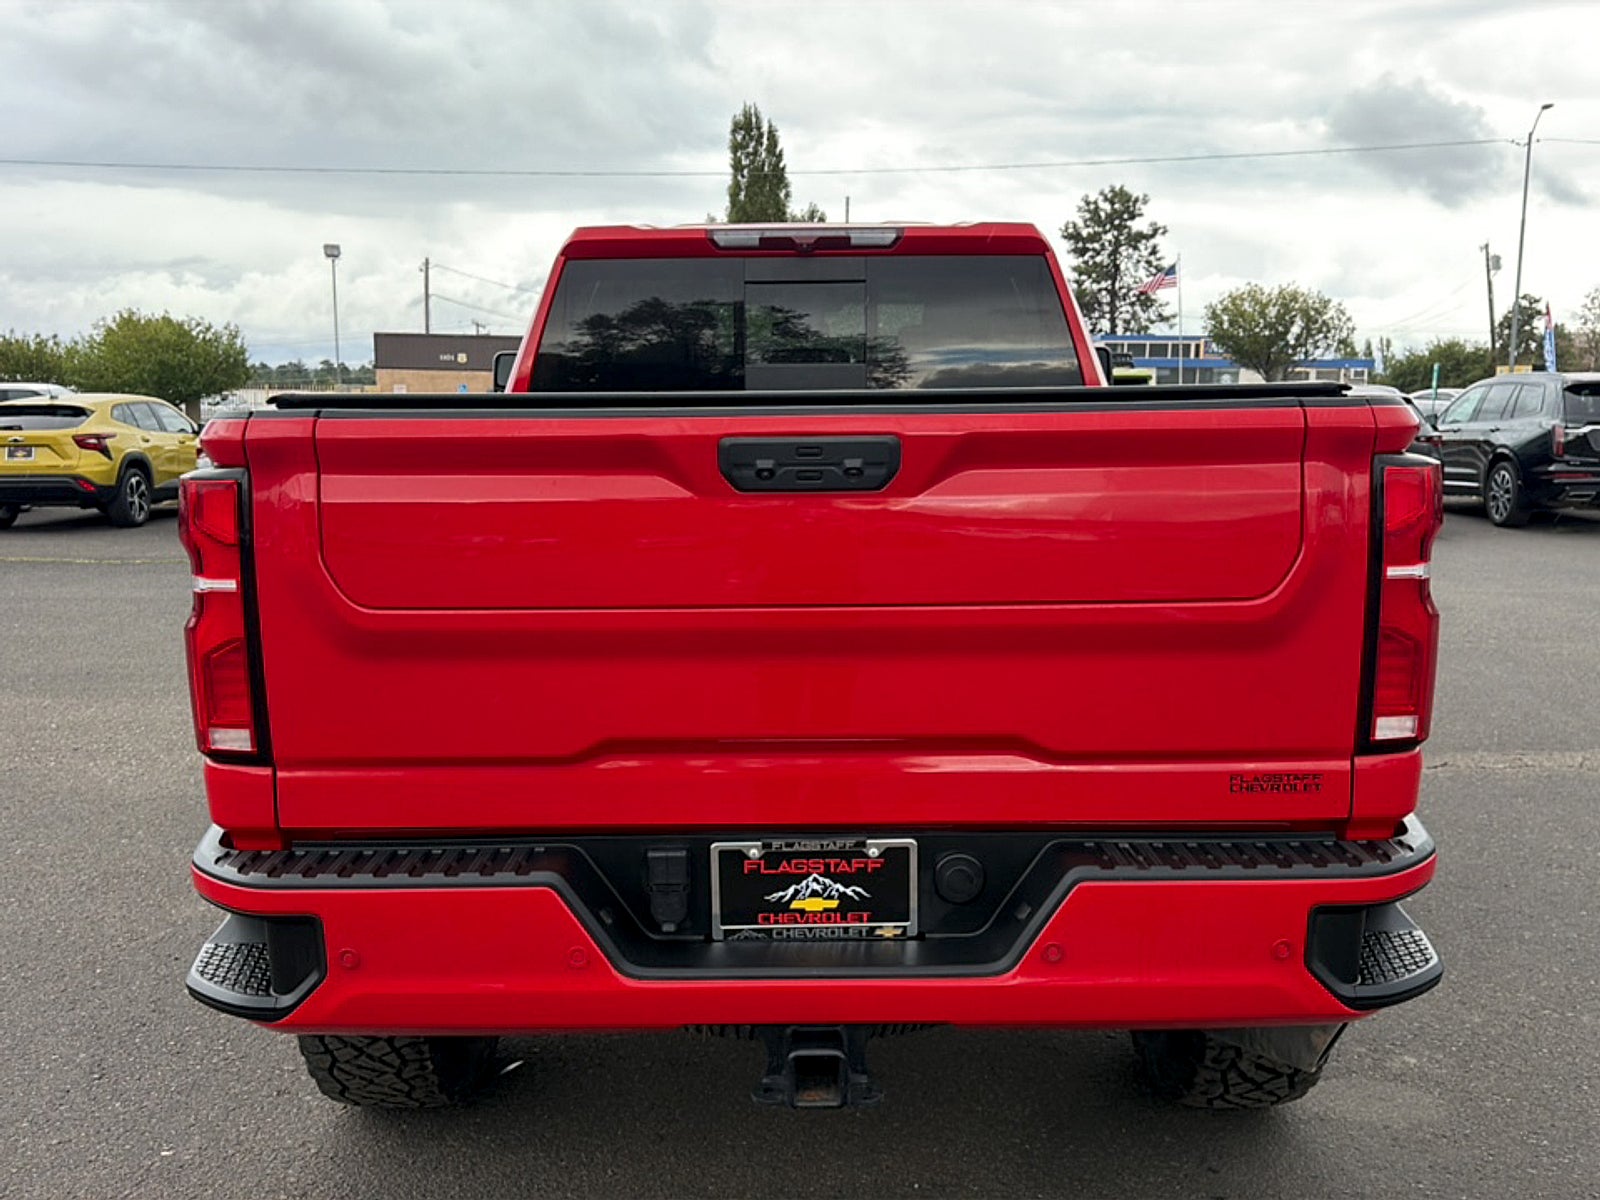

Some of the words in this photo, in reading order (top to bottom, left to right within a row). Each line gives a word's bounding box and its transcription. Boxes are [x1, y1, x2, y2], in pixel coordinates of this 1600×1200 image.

[771, 840, 857, 851] FLAGSTAFF
[743, 859, 885, 874] FLAGSTAFF
[757, 912, 872, 924] CHEVROLET
[772, 927, 870, 939] CHEVROLET
